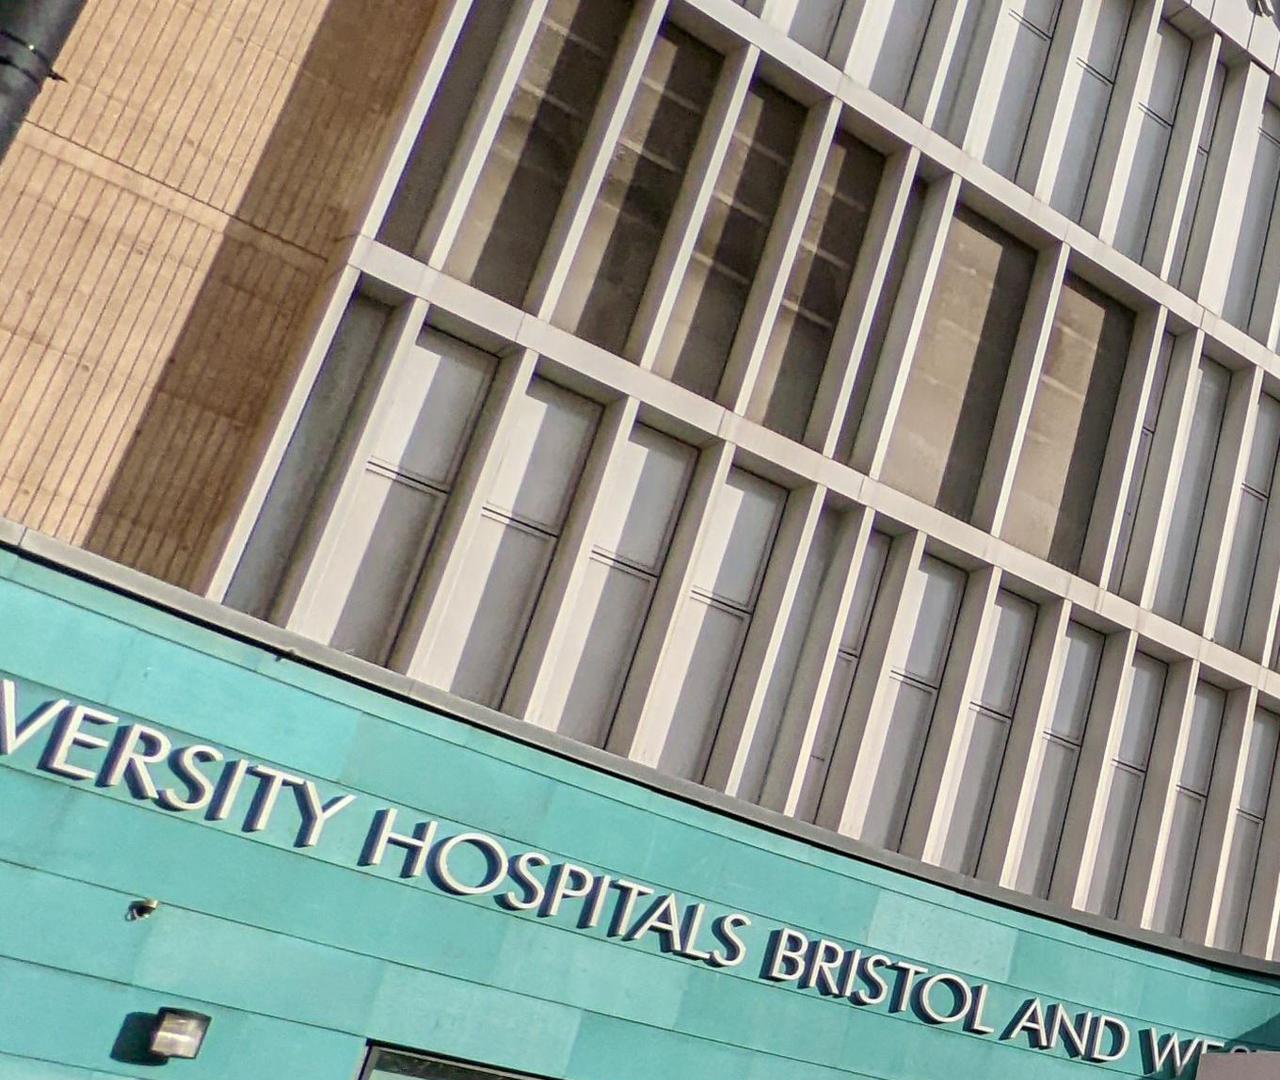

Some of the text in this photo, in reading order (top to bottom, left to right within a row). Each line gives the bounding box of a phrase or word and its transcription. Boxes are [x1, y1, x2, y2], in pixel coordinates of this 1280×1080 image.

[360, 807, 752, 968] HOSPITALS
[763, 926, 994, 1034] BRISTOL
[1001, 996, 1130, 1063] AND
